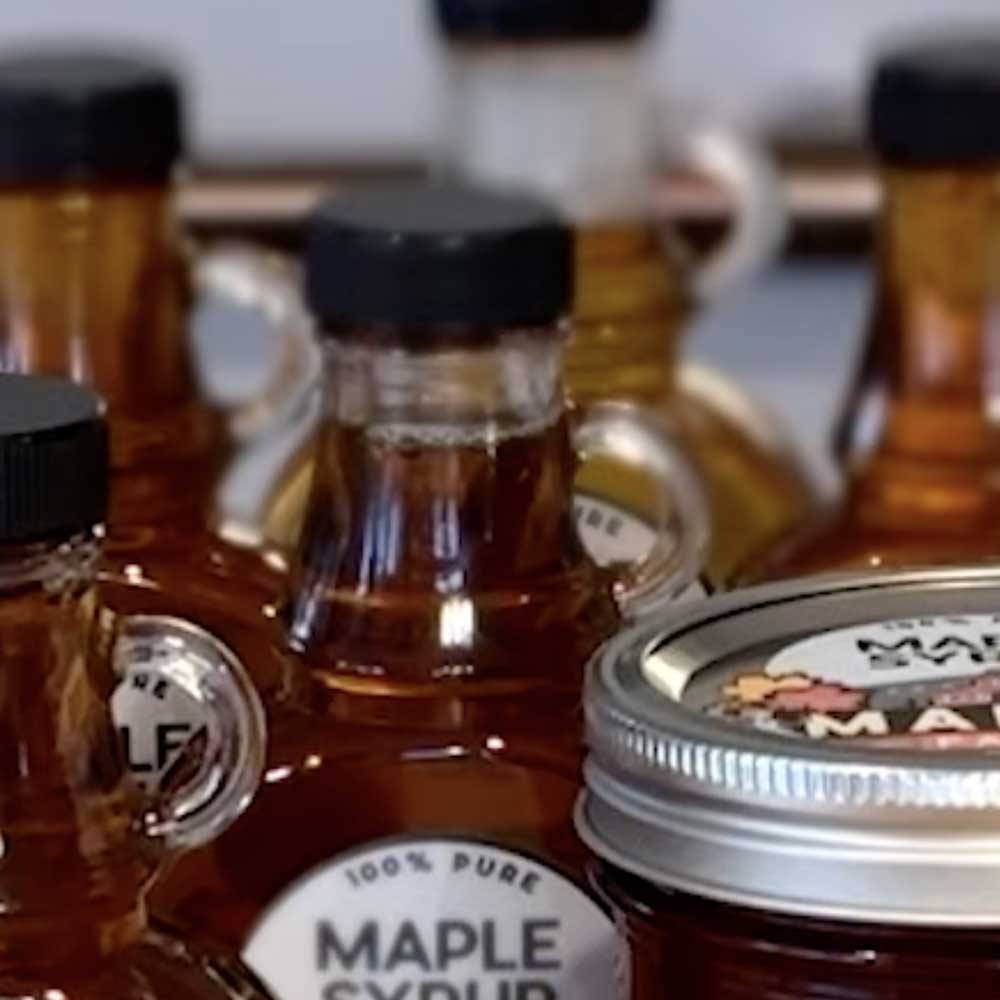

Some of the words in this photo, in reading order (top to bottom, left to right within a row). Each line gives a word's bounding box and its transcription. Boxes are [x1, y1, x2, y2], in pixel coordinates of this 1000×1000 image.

[345, 851, 433, 887] 100%
[453, 852, 541, 895] PURE
[315, 918, 562, 972] MAPLE
